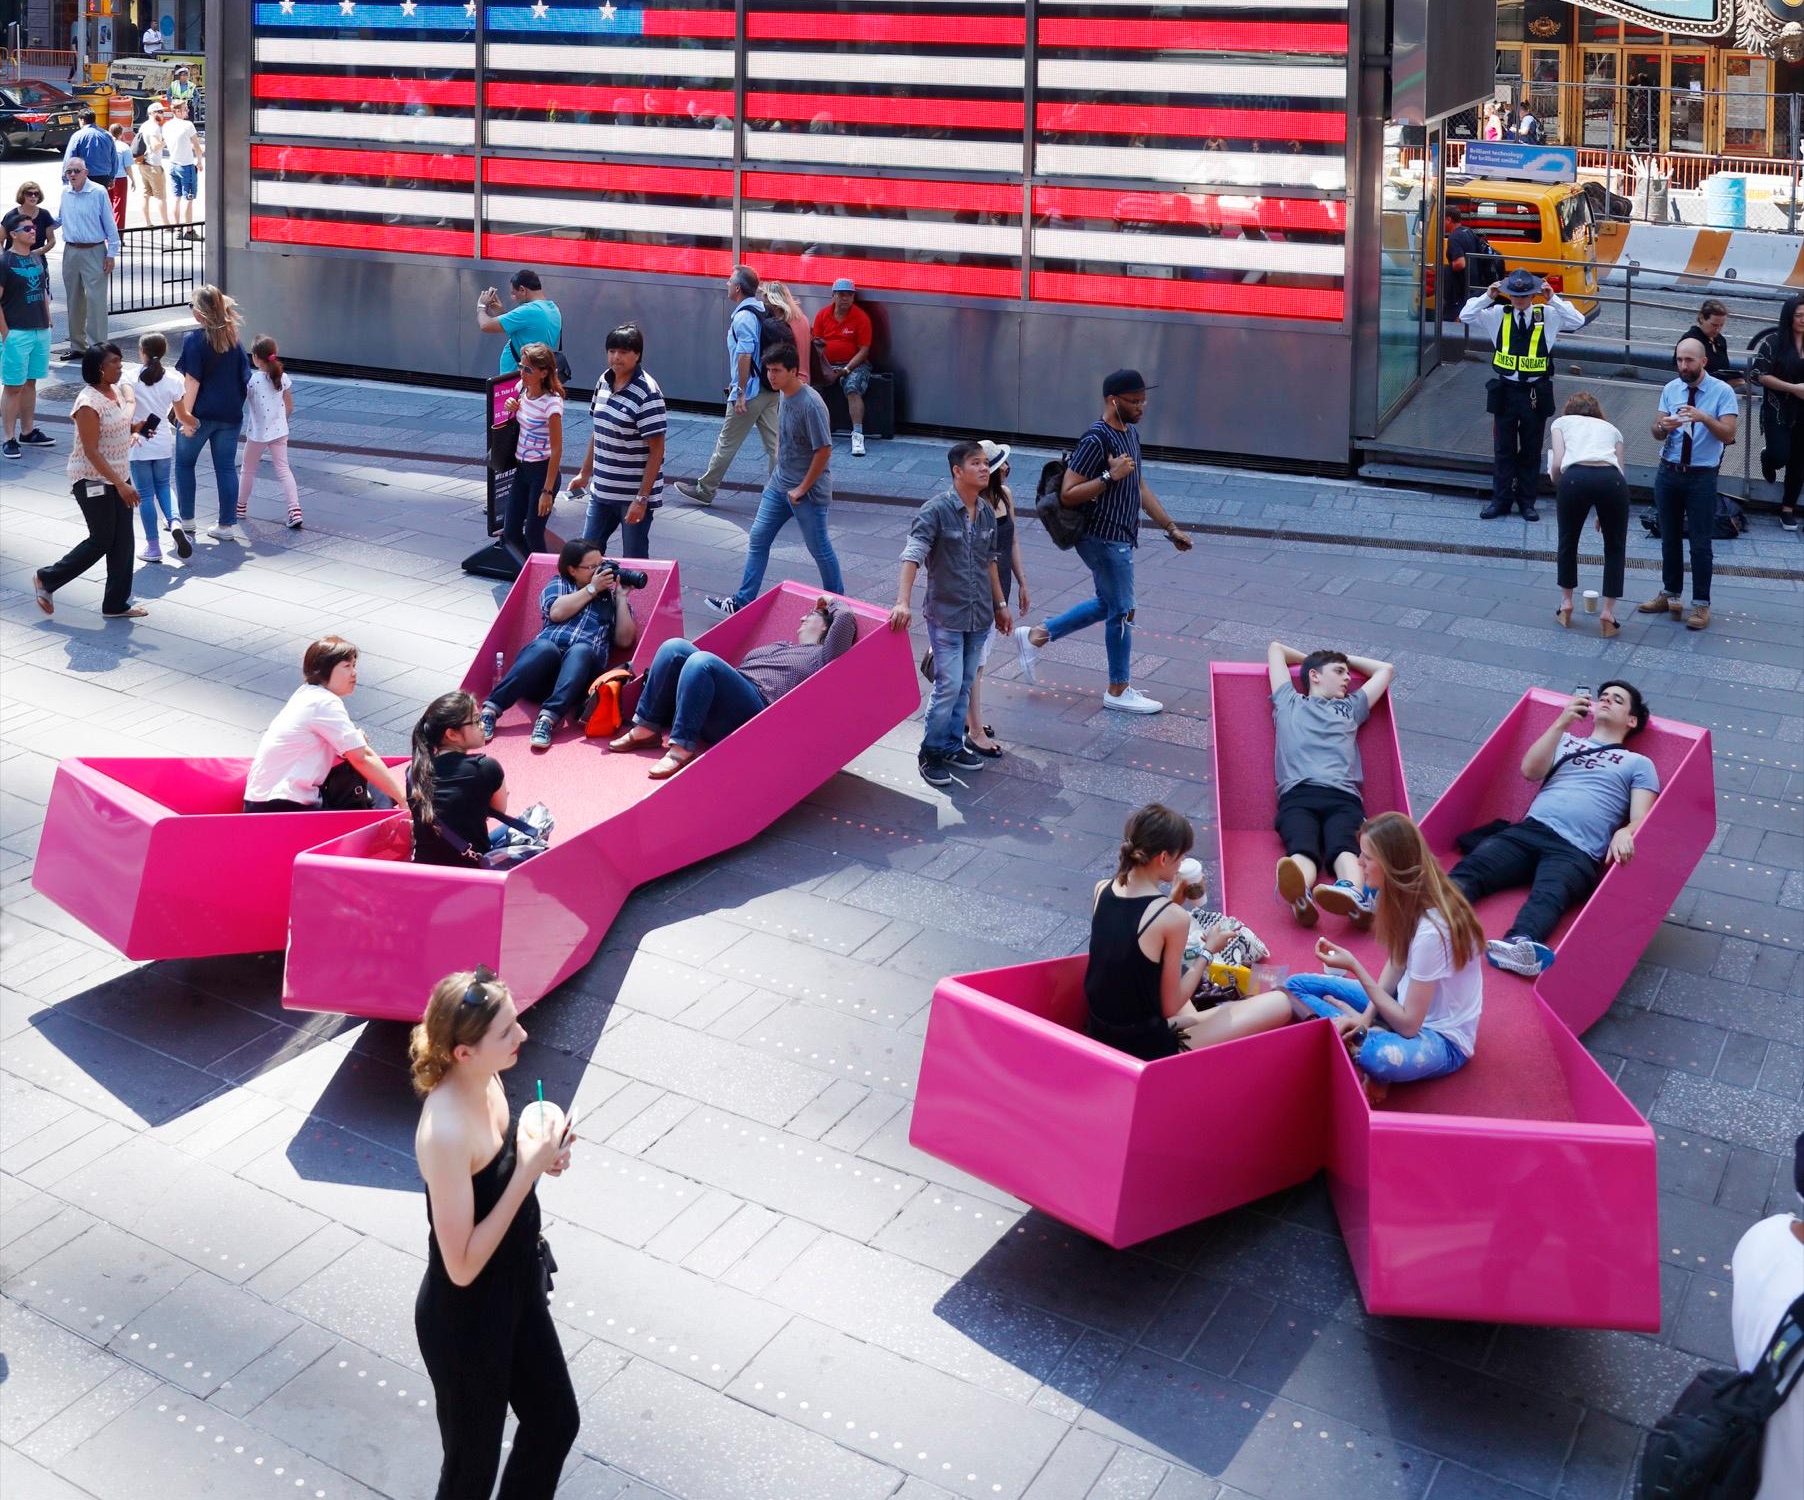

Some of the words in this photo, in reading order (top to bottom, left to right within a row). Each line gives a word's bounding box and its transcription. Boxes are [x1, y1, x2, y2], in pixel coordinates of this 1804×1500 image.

[1469, 147, 1491, 155] Brilliant
[1491, 150, 1524, 159] technology
[1520, 357, 1545, 369] SQUARE
[1563, 739, 1624, 765] FICH
